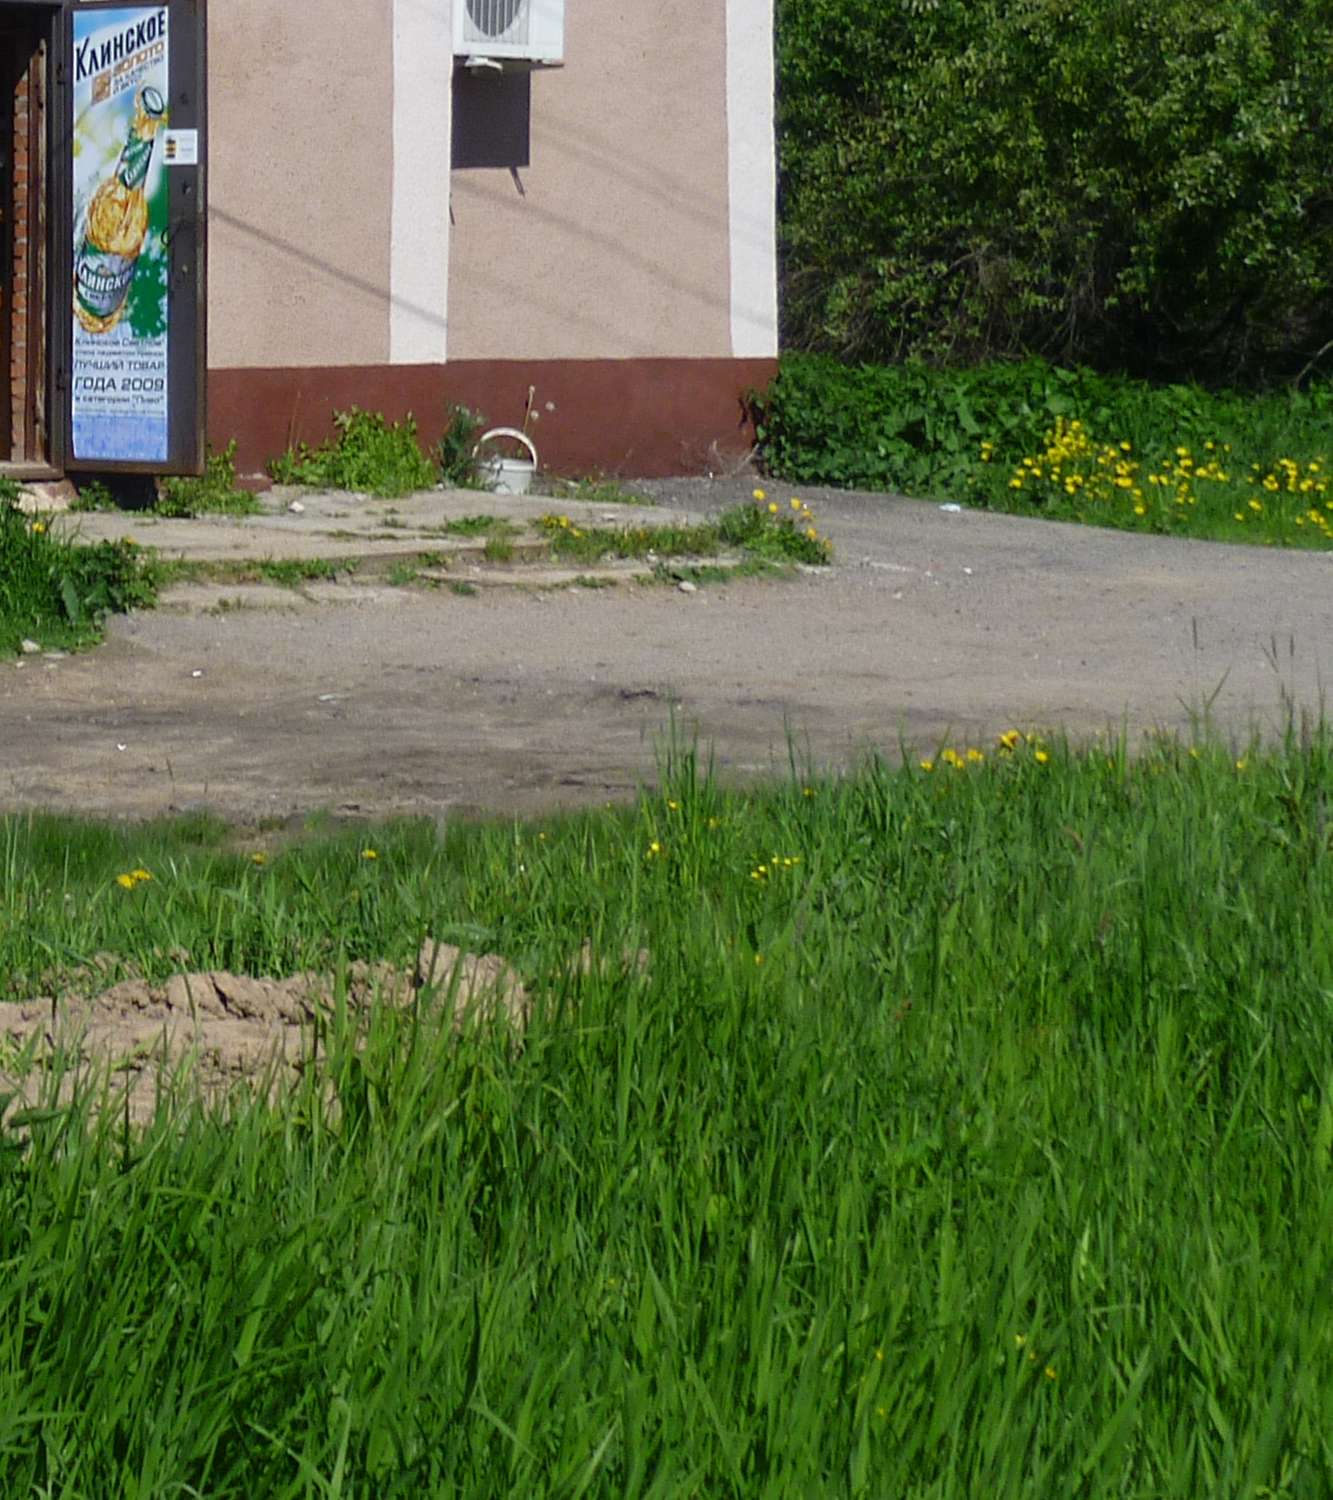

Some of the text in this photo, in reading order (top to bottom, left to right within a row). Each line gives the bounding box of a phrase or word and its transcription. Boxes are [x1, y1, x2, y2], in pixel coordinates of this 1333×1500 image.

[75, 360, 124, 370] ЛУЧШИЙ
[75, 376, 165, 393] ГОДА 2009
